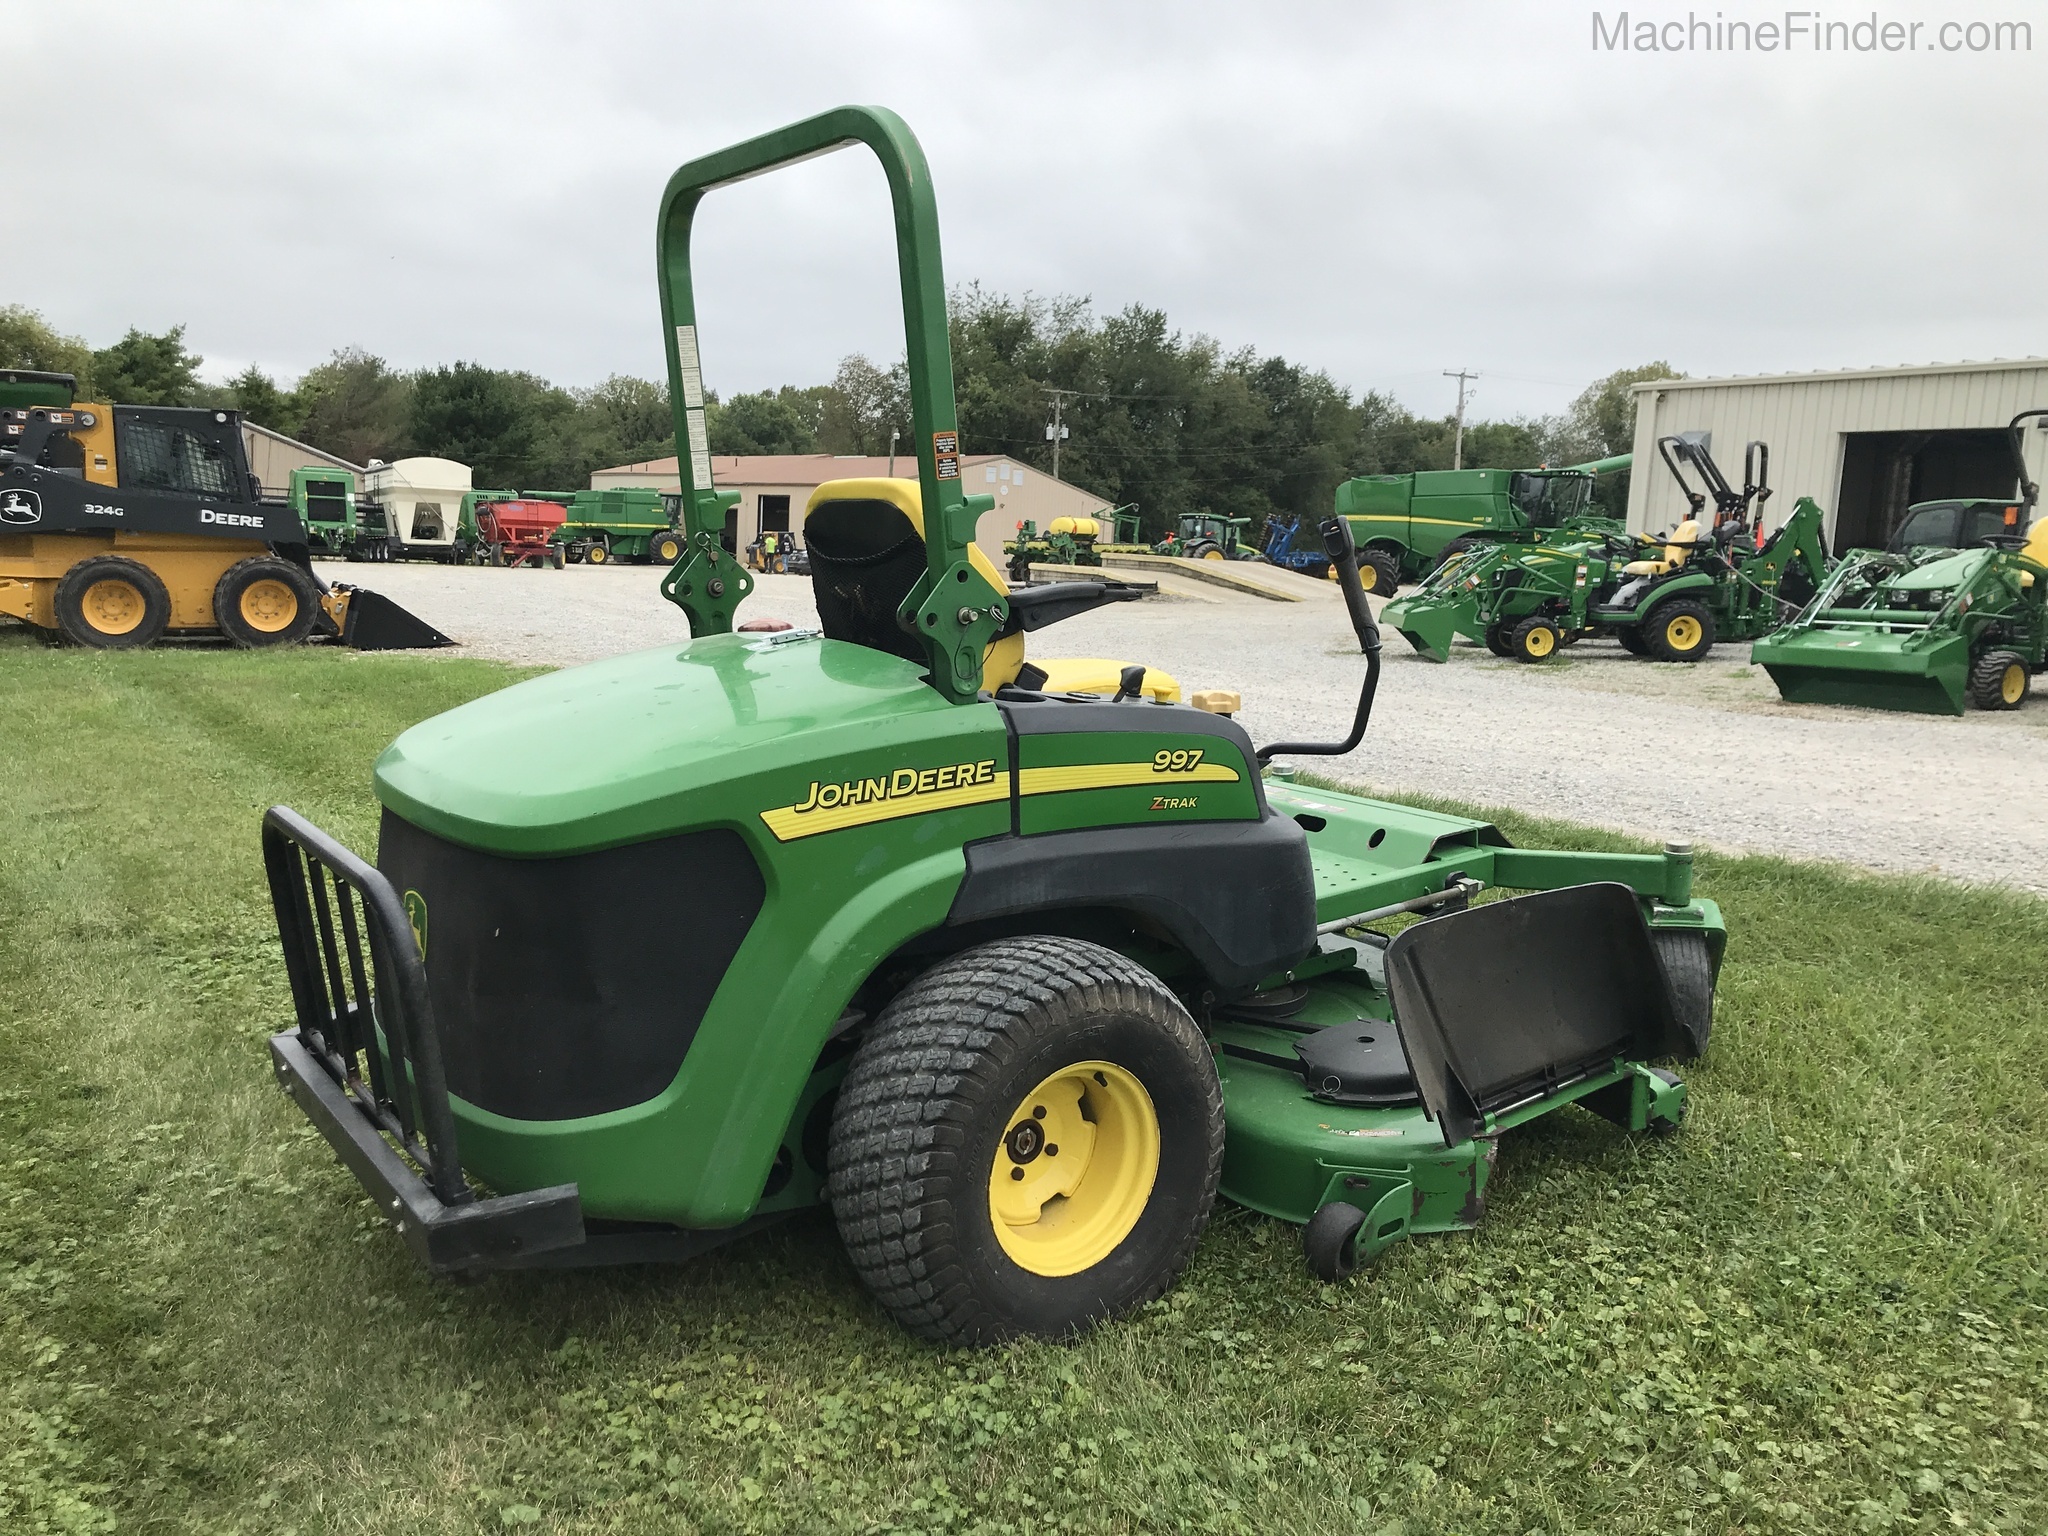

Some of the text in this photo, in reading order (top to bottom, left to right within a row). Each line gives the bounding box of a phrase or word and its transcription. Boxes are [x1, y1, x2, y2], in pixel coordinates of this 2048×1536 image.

[84, 504, 124, 516] 324G
[200, 509, 264, 528] DEERE
[1153, 749, 1204, 771] 997
[794, 758, 996, 813] JOHN DEERE
